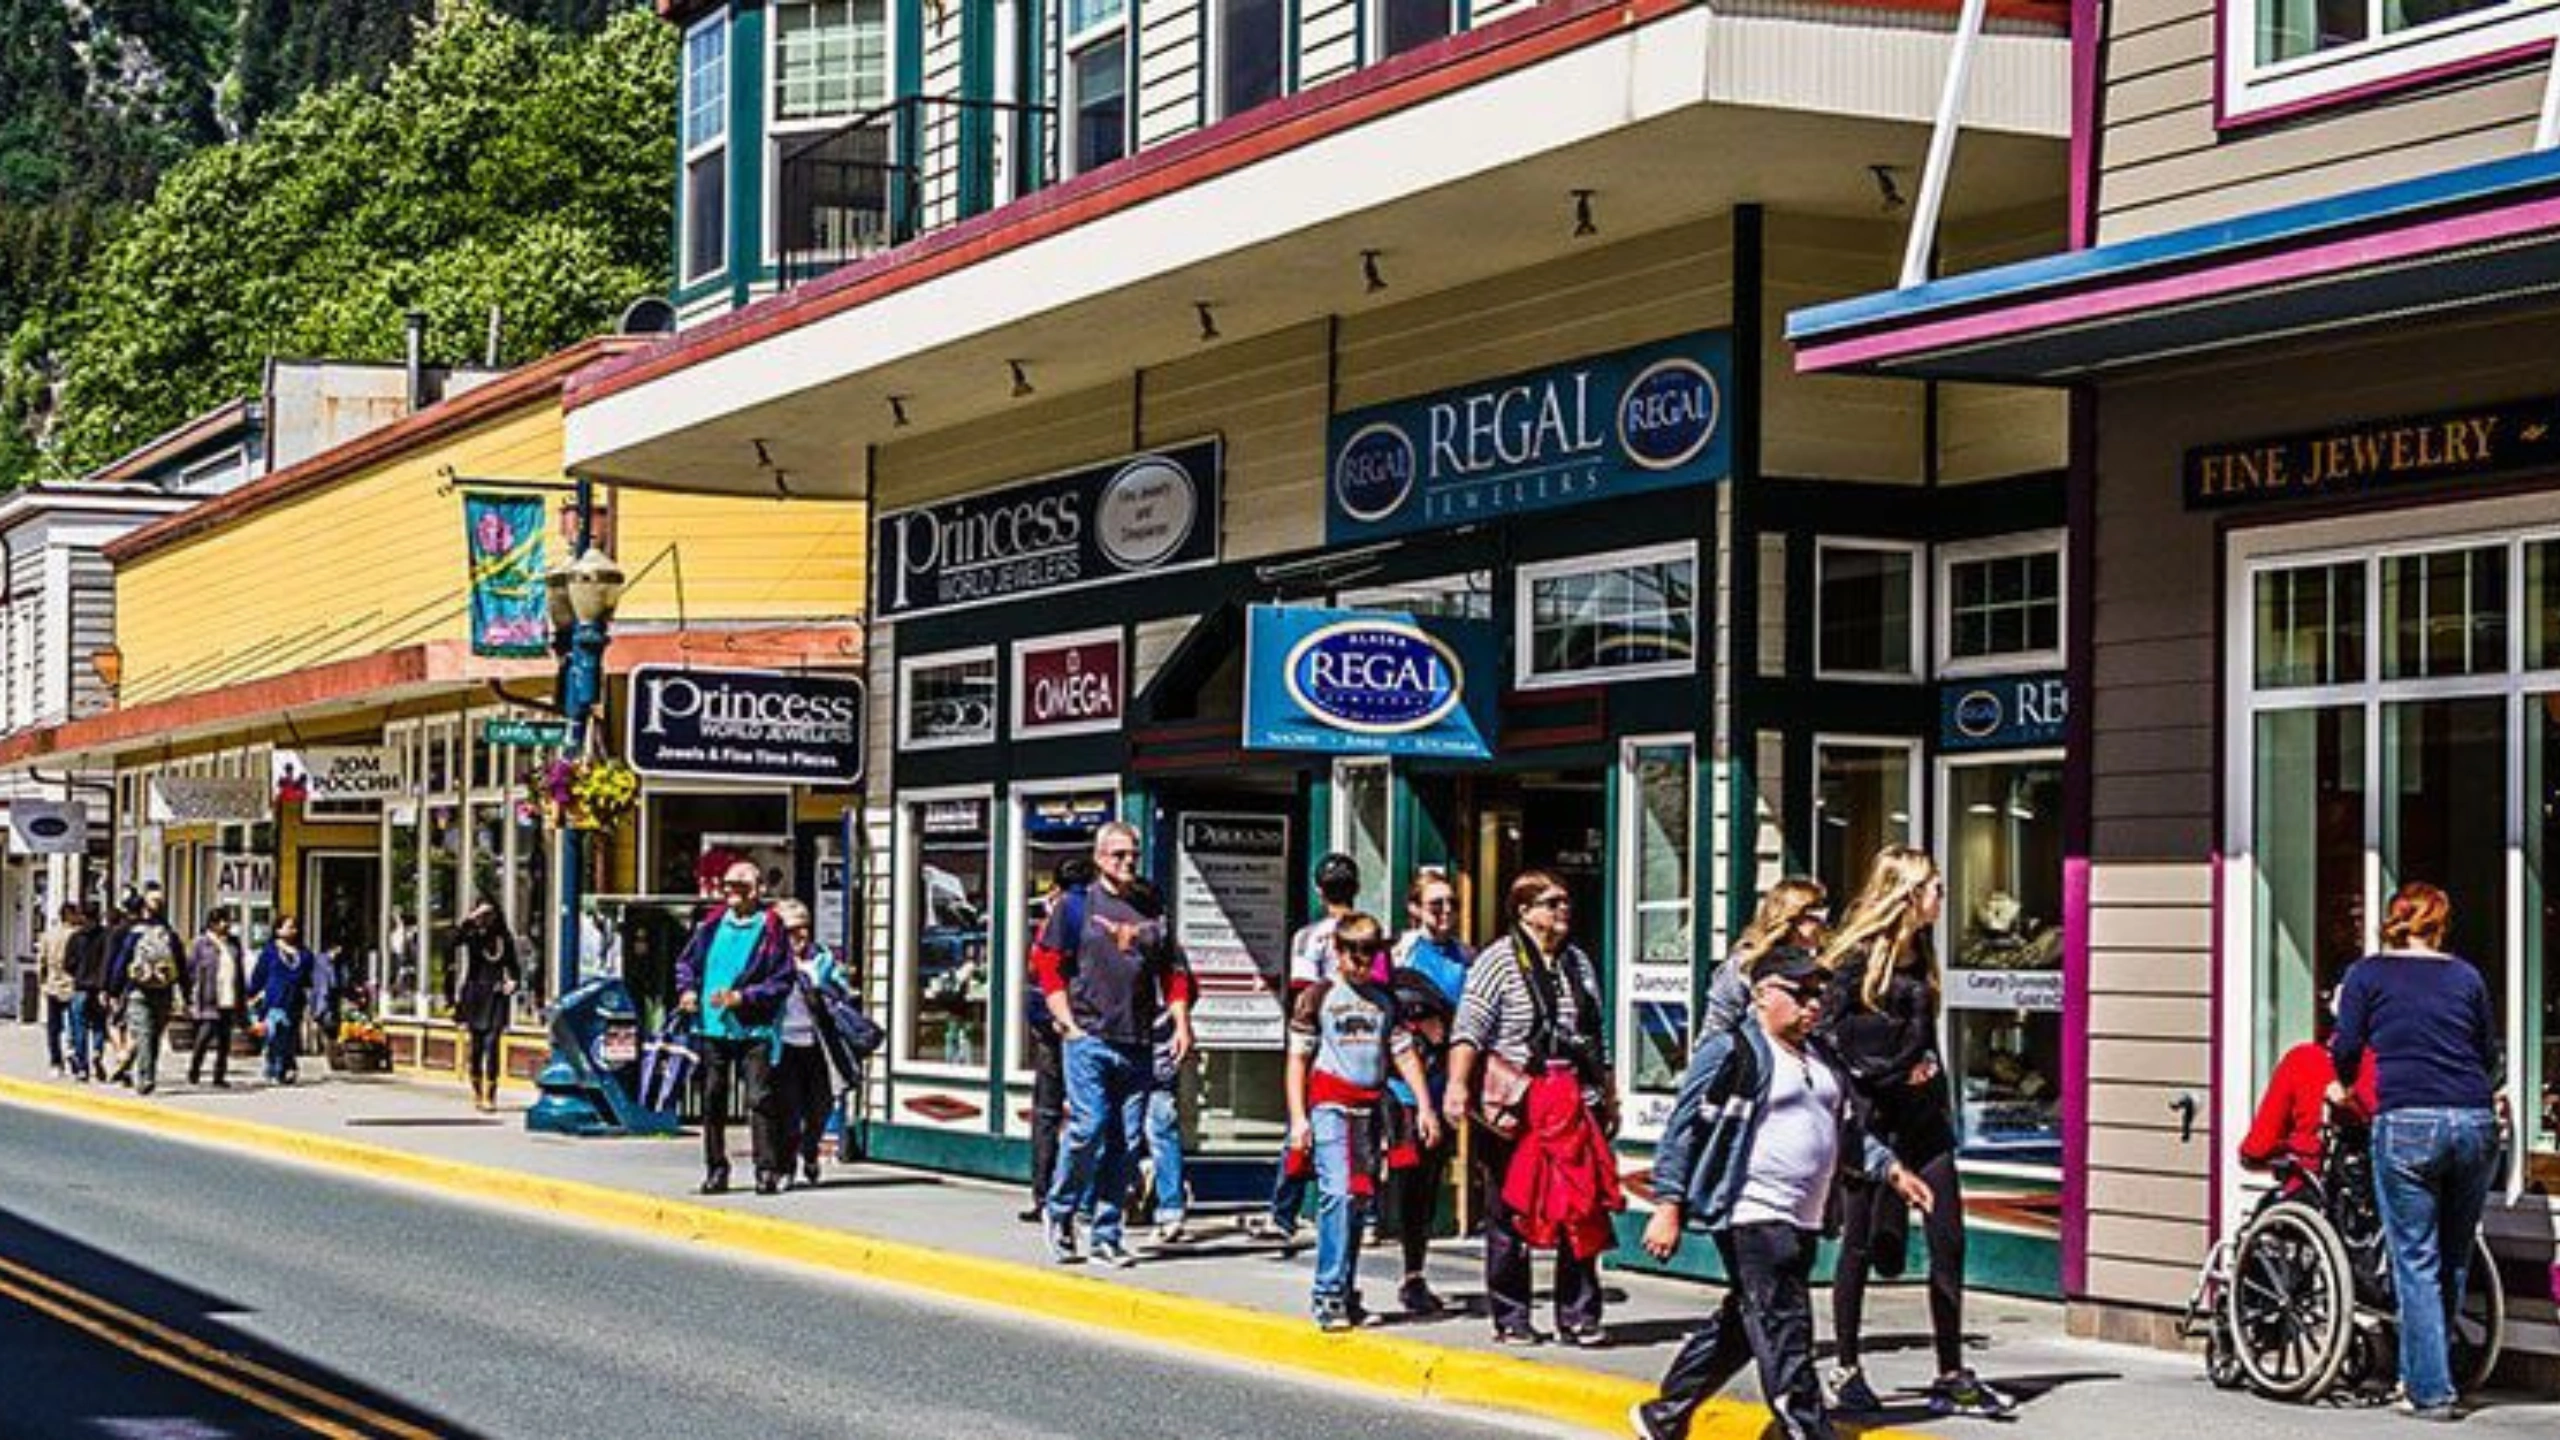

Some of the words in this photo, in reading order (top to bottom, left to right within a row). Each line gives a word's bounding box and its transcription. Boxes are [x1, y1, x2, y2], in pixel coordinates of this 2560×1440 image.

[1427, 371, 1604, 478] REGAL
[1629, 385, 1709, 434] REGAL
[1345, 449, 1407, 487] REGAL
[2201, 447, 2288, 495] FINE
[2303, 416, 2498, 485] JEWELRY
[1425, 471, 1598, 521] JEWELERS
[938, 571, 990, 600] WORLD
[995, 552, 1081, 593] JEWELERS
[1035, 671, 1113, 719] OMEGA
[1310, 651, 1449, 692] REGAL
[701, 721, 761, 739] WORLD
[333, 756, 380, 775] ДОМ
[218, 860, 271, 892] ATM
